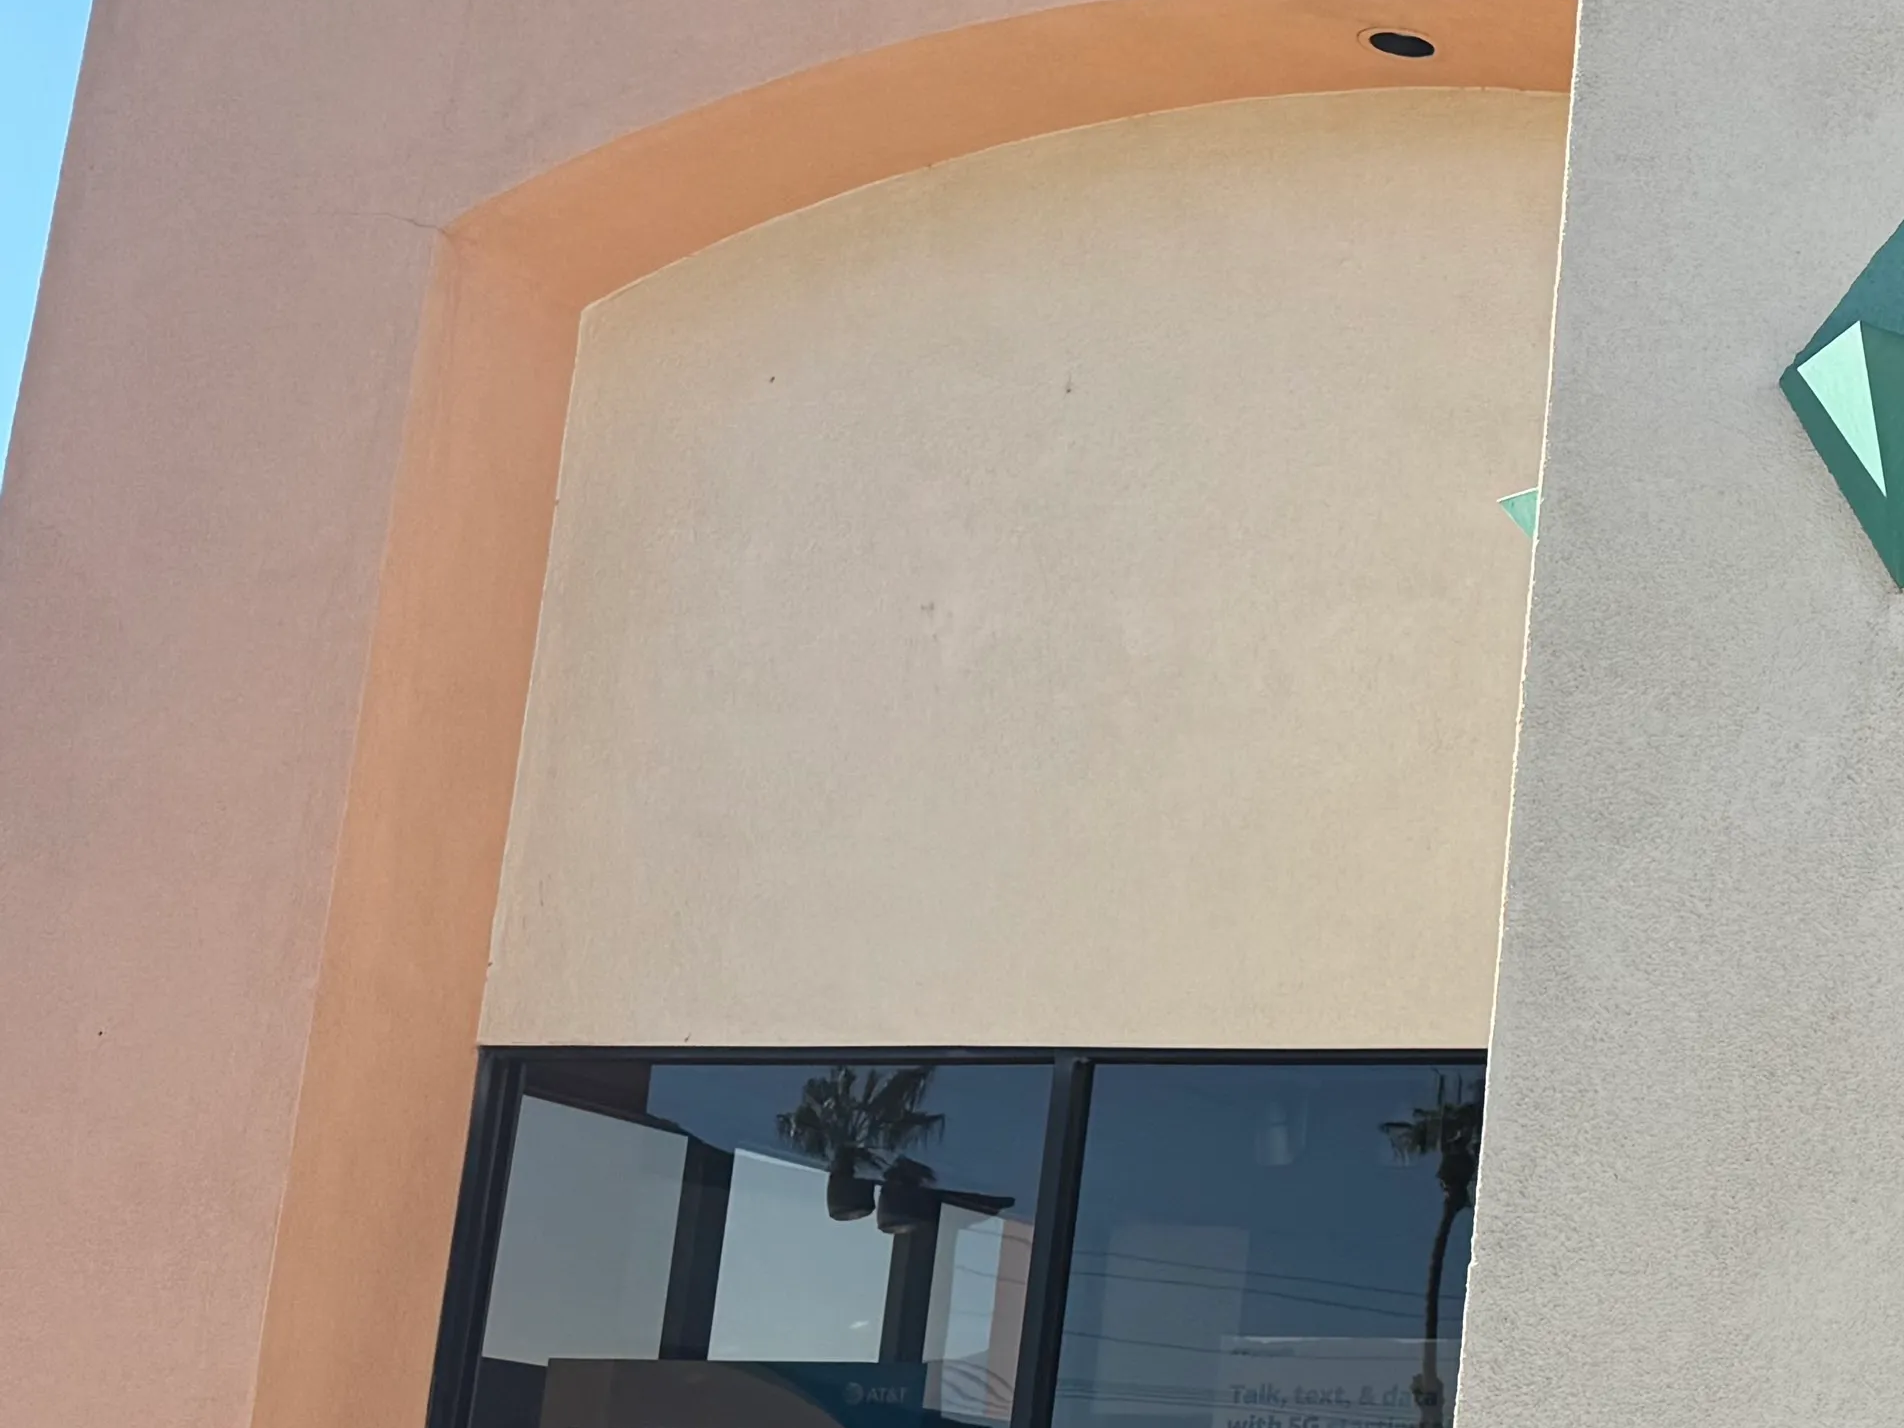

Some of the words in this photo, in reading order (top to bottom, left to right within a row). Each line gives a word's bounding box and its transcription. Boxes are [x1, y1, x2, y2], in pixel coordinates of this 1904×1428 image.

[866, 1387, 908, 1405] AT&T
[1229, 1383, 1287, 1408] Talk,
[1294, 1384, 1351, 1409] text,
[1359, 1385, 1377, 1405] &
